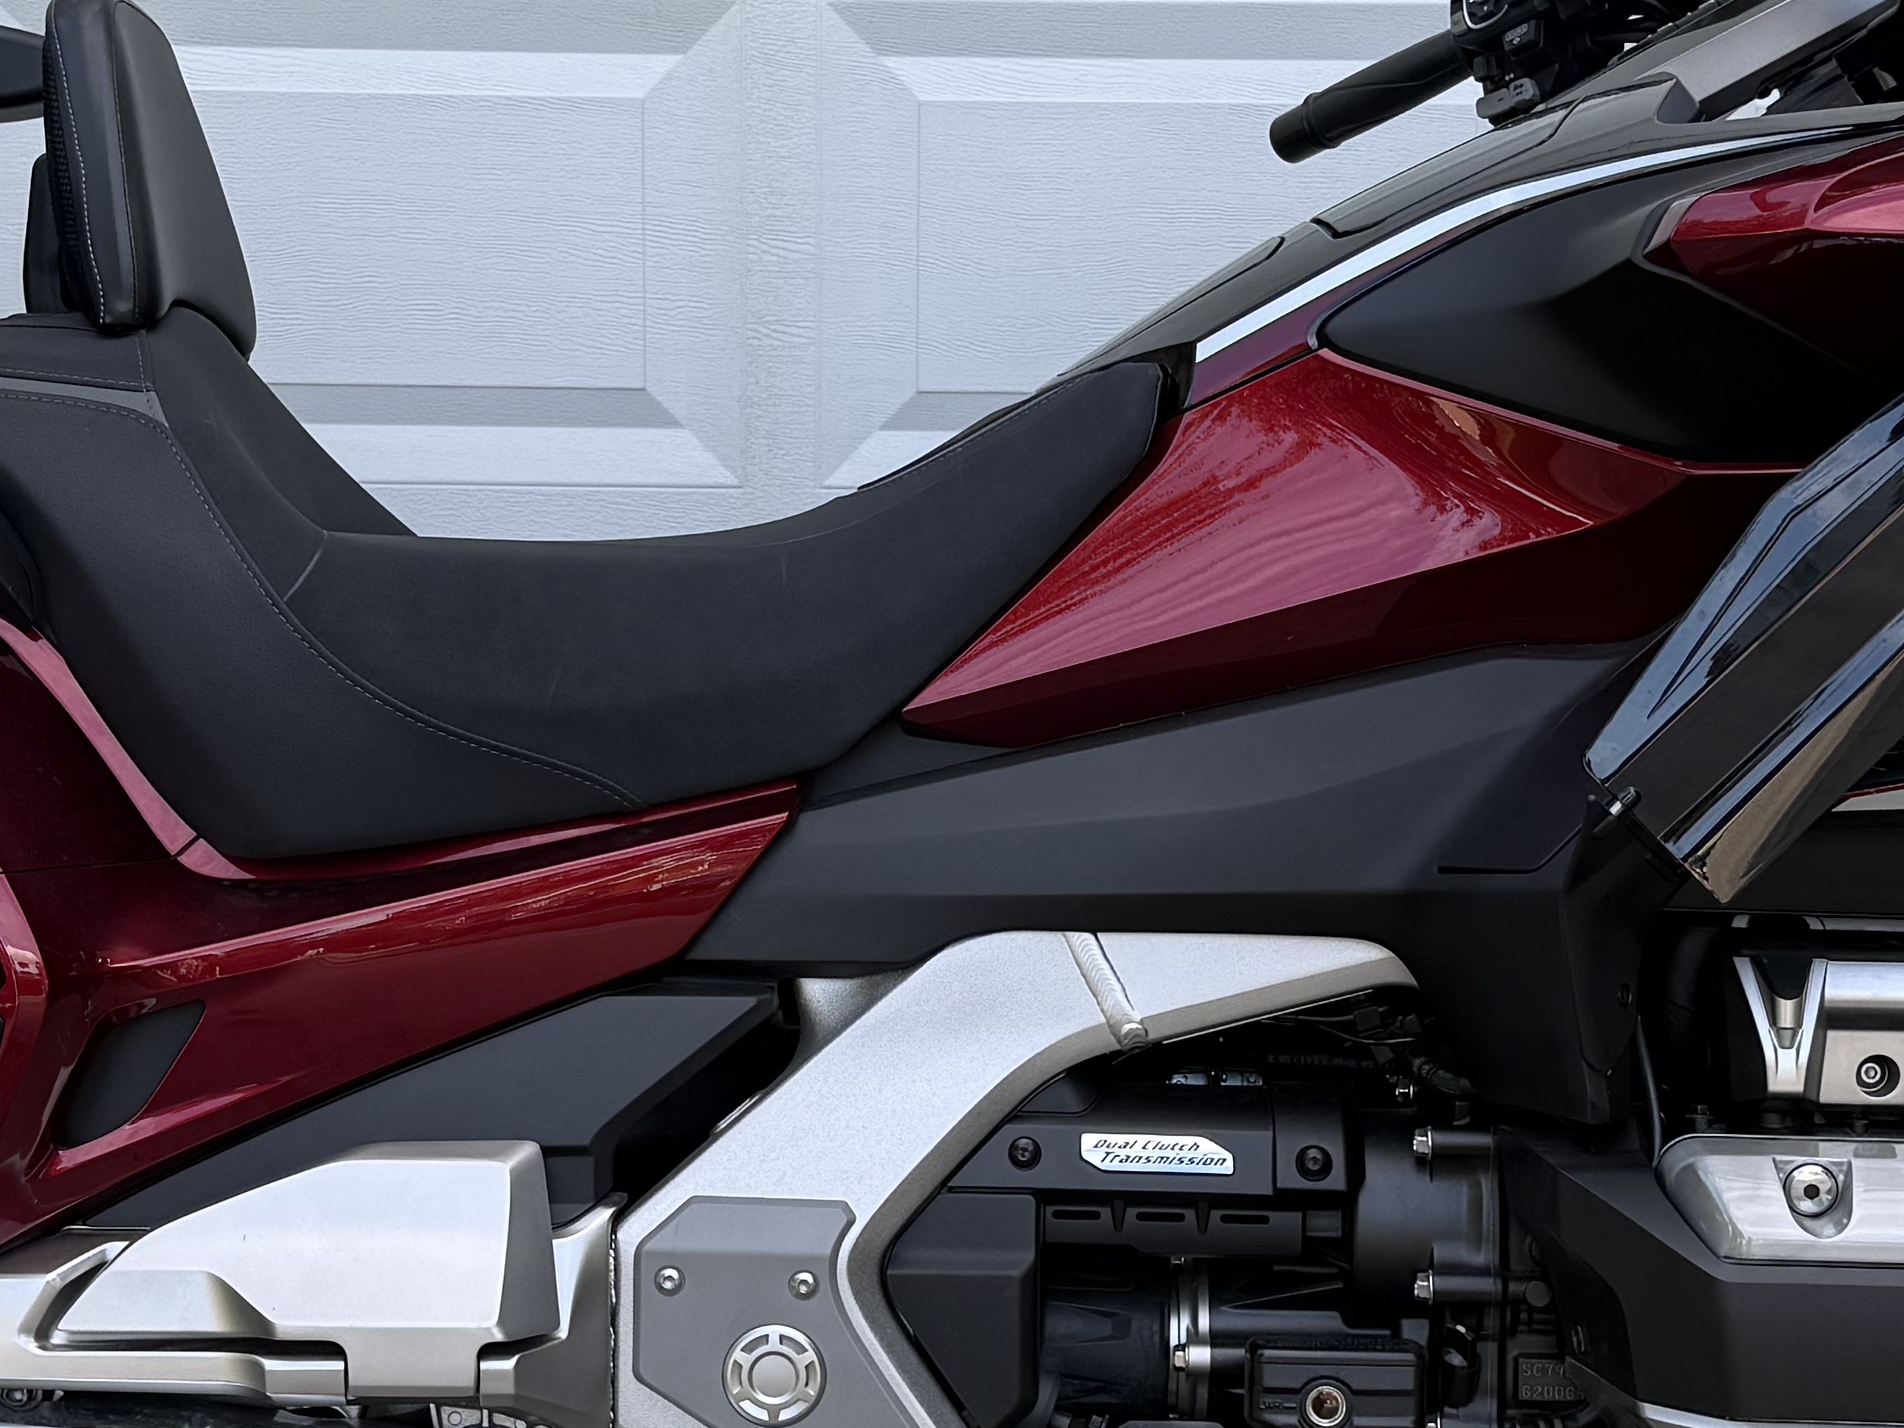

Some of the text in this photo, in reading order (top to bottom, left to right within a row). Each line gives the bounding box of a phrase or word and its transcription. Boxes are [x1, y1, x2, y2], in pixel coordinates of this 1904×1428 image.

[1092, 1139, 1200, 1152] Dual Clutch
[1100, 1151, 1227, 1167] Transmission
